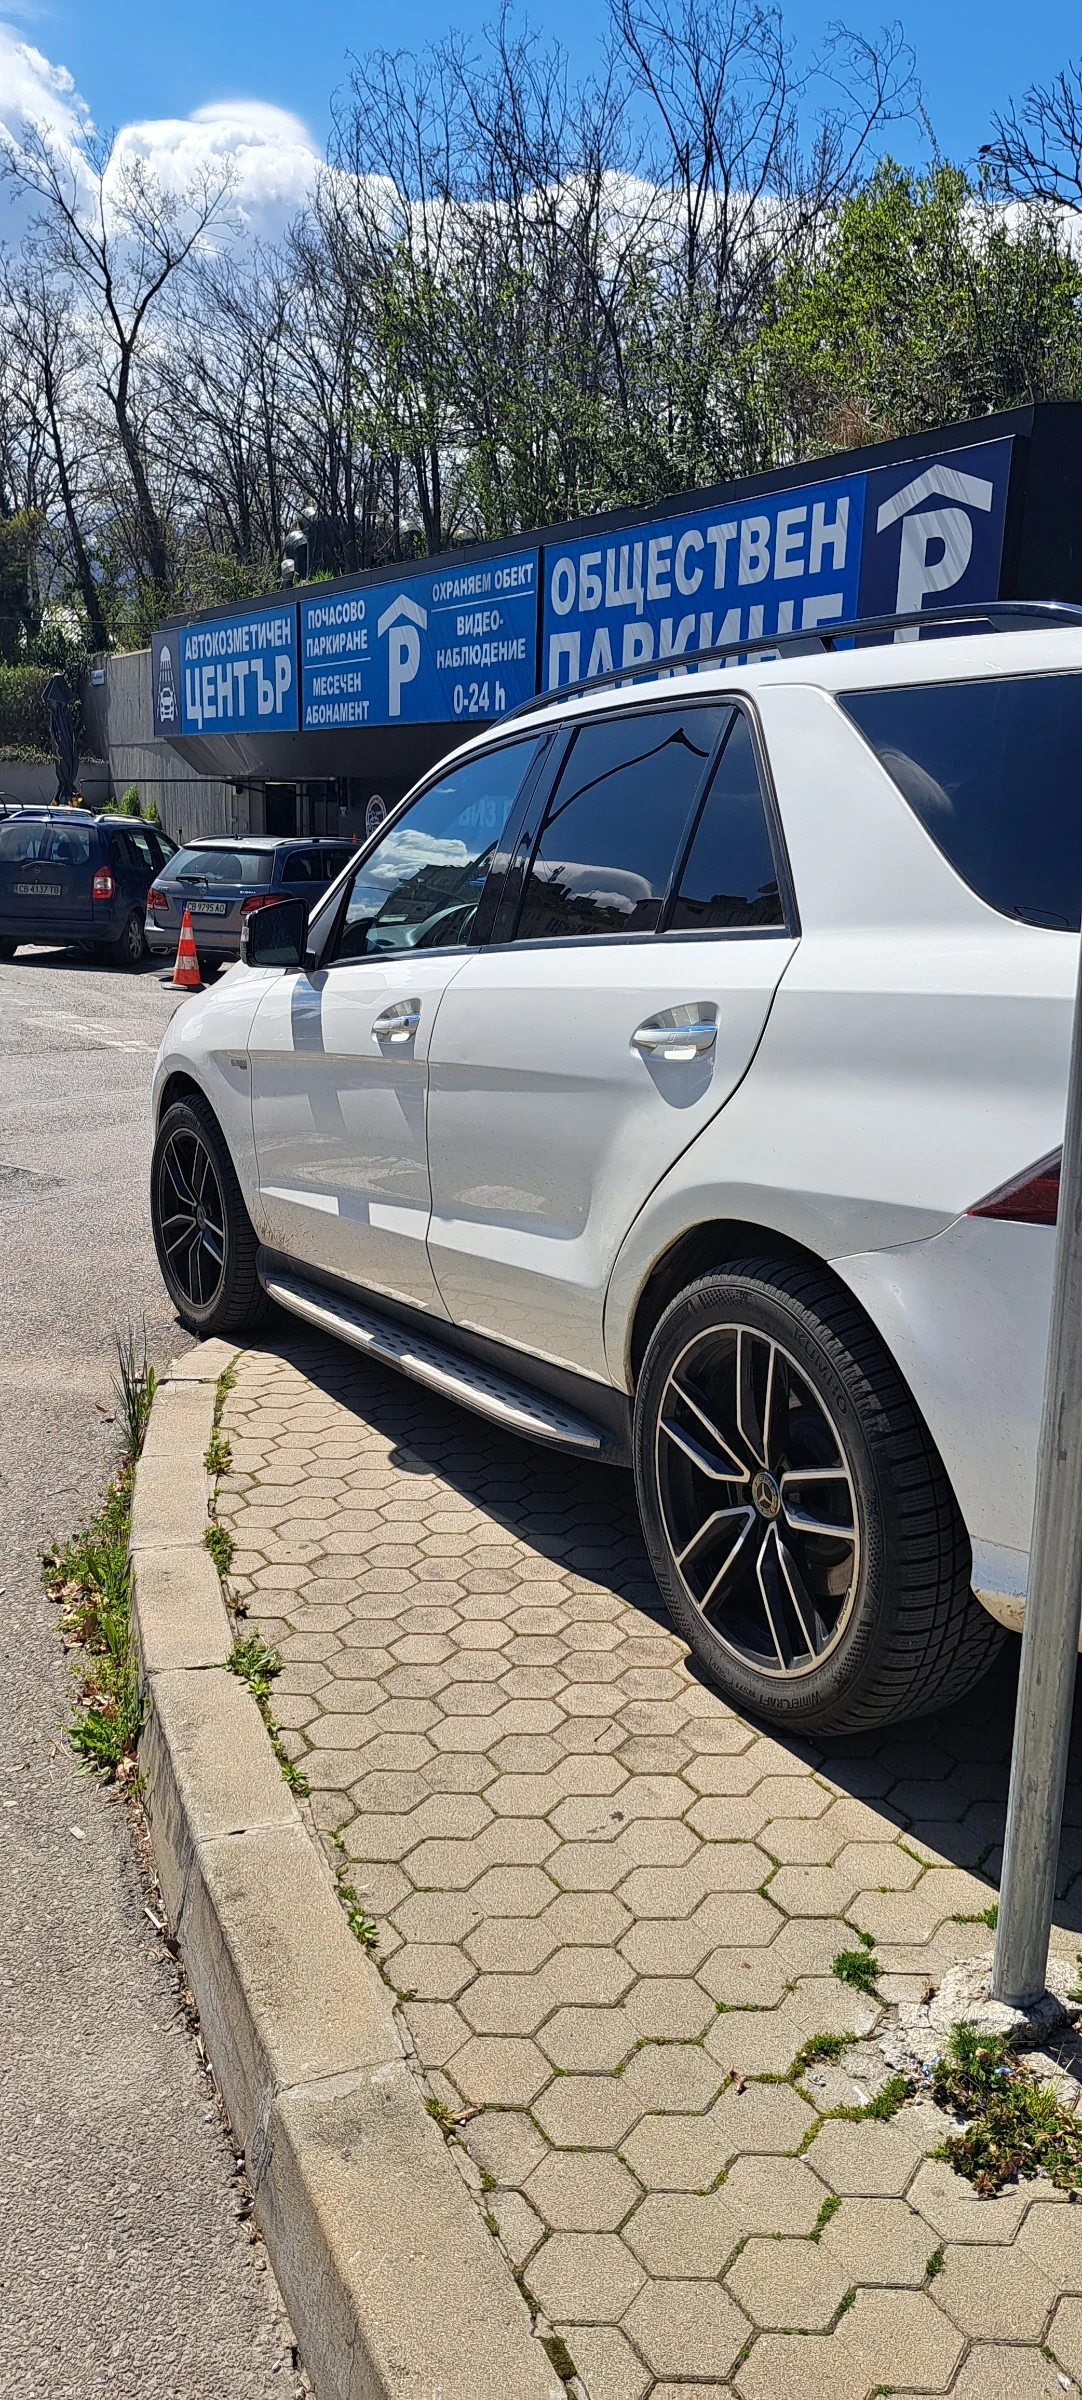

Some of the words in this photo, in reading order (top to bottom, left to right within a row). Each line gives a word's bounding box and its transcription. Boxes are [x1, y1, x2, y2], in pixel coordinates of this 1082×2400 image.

[550, 496, 849, 616] ОБЩЕСТВЕН
[432, 572, 491, 602] ОХРАНЯЕМ
[494, 562, 534, 590] ОБЕКТ
[307, 599, 366, 630] ПОЧАСОВО
[456, 609, 504, 637] ВИДЕО-
[184, 617, 292, 661] АВТОКОЗМЕТИЧЕН
[306, 628, 368, 658] ПАРКИРАНЕ
[436, 637, 526, 669] НАБЛЮДЕНИЕ
[185, 654, 292, 730] ЦЕНТЪР
[312, 672, 362, 697] МЕСЕЧЕН
[453, 681, 490, 715] 0-24
[494, 680, 506, 711] h
[305, 700, 370, 725] АБОНАМЕНТ
[187, 902, 197, 911] CB
[197, 903, 214, 912] 9795
